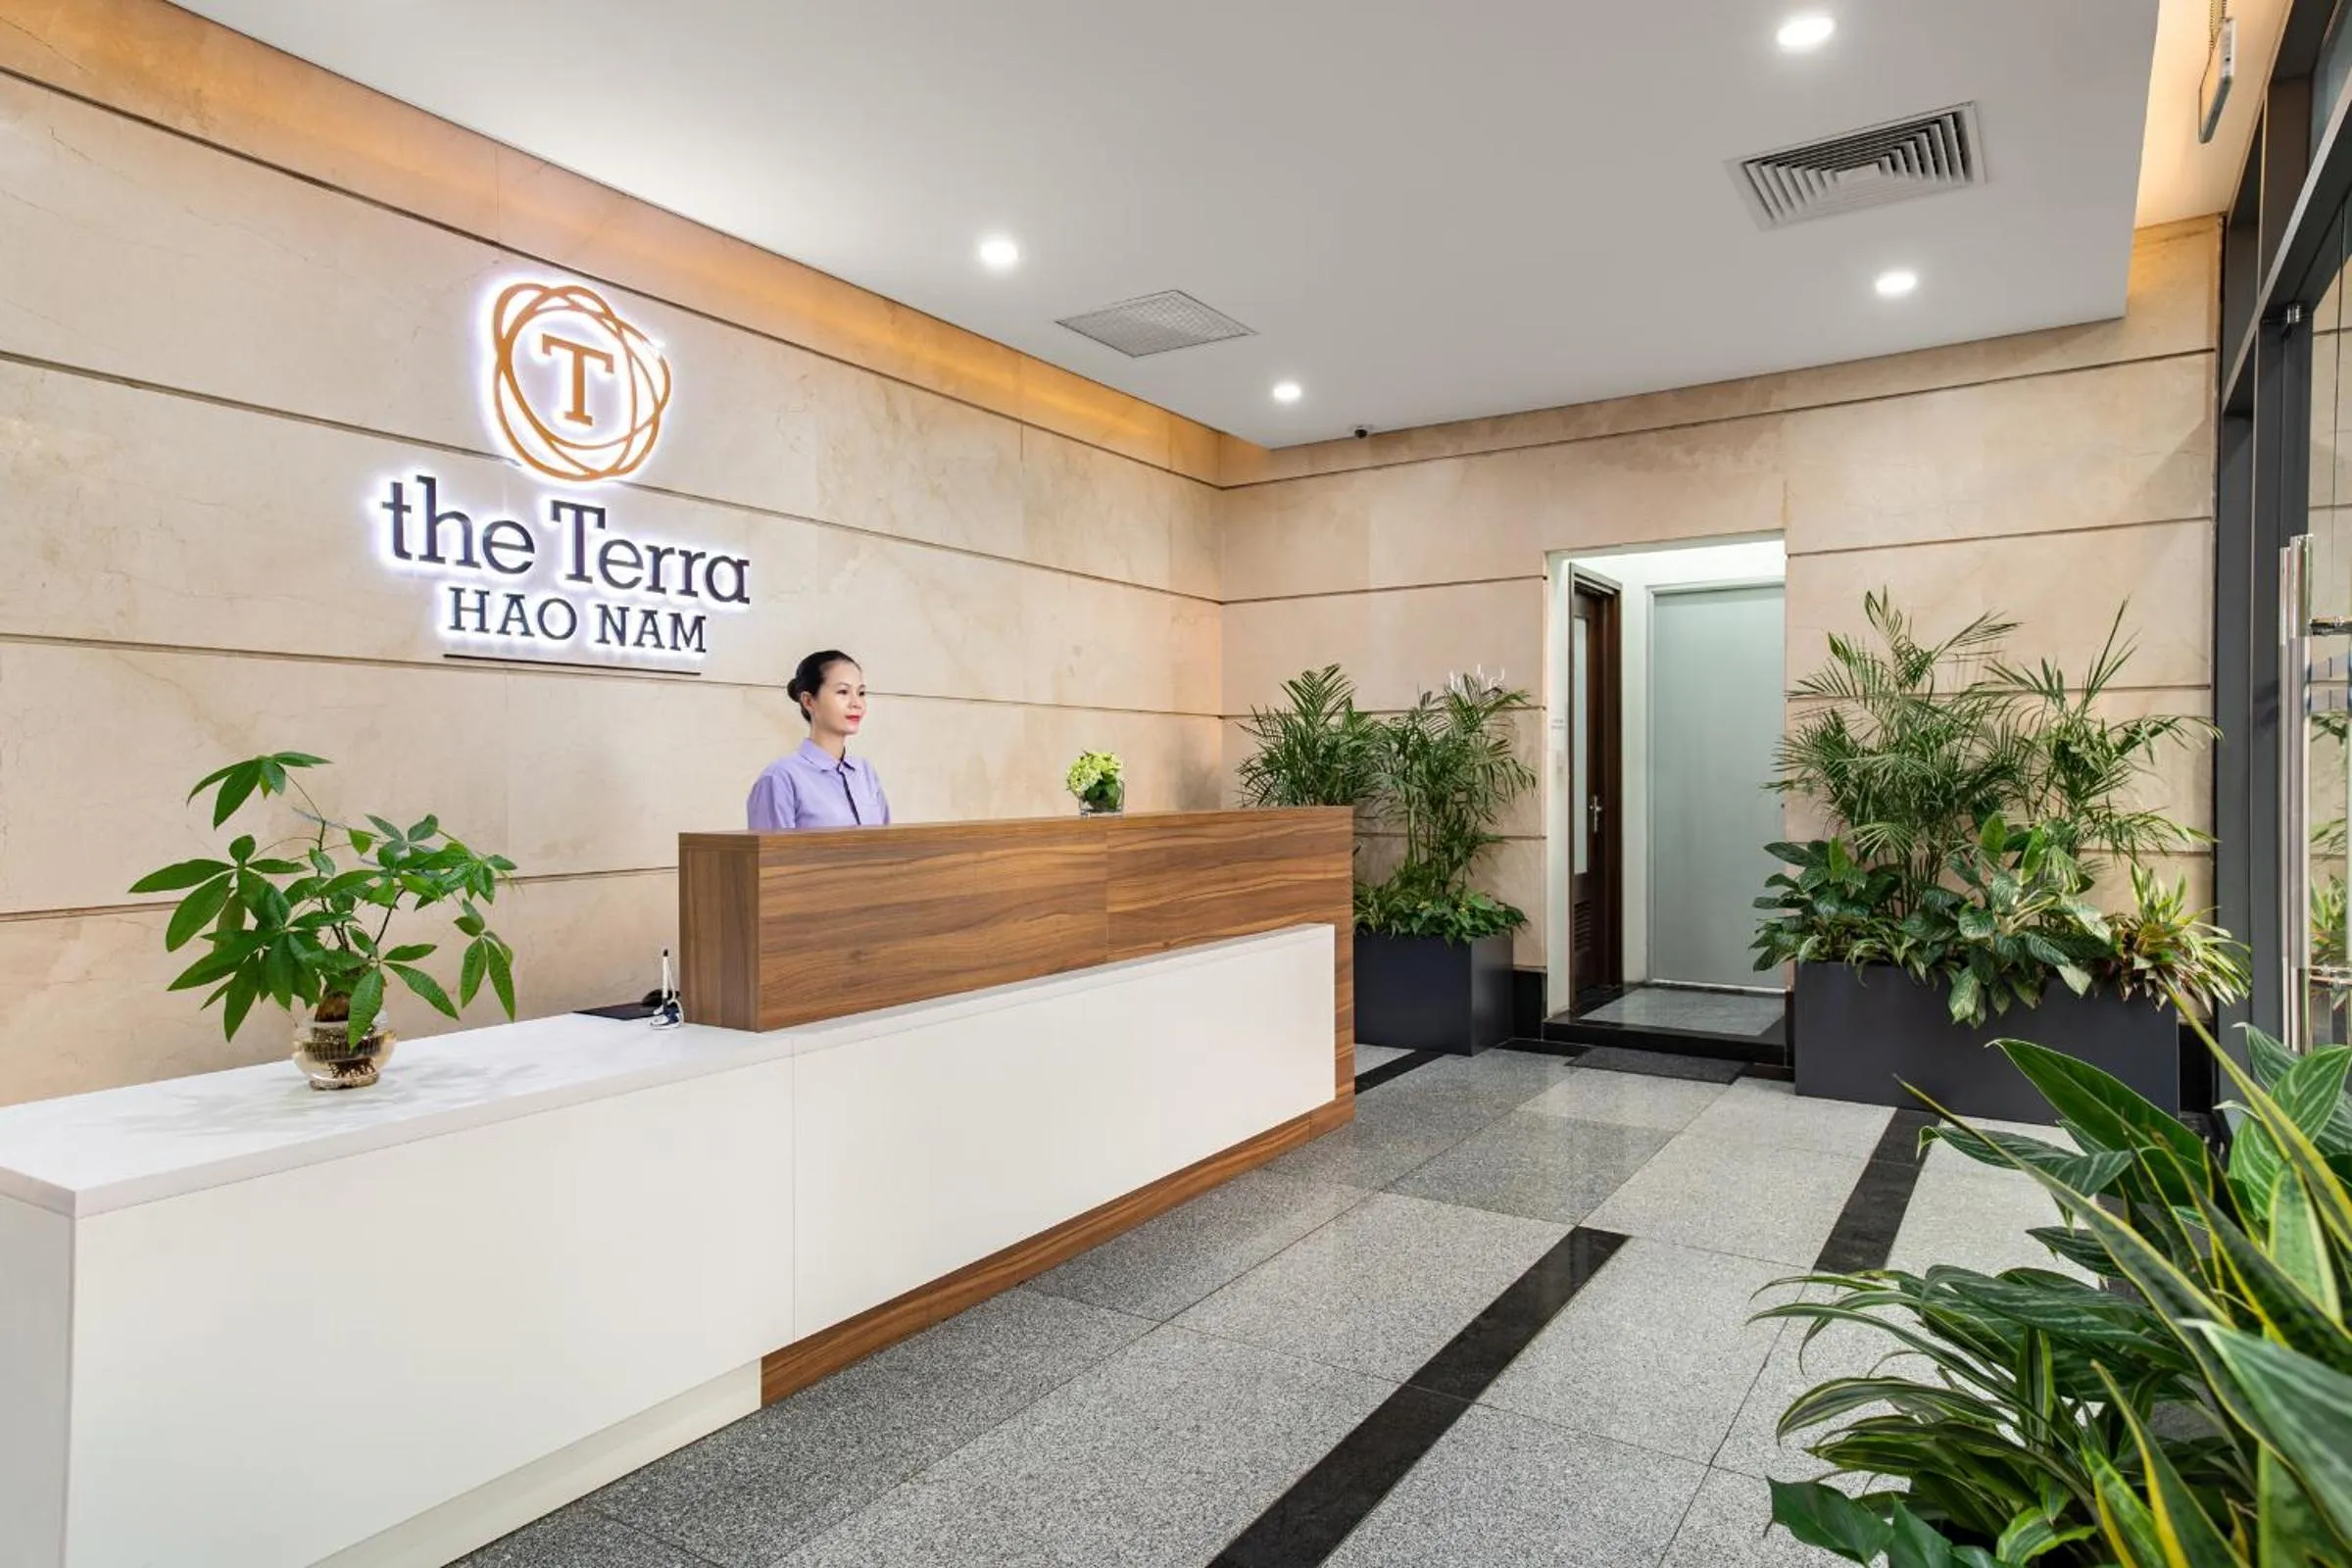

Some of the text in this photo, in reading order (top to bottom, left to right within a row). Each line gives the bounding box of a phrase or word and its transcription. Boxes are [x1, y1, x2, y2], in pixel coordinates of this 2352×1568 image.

[542, 333, 614, 425] T
[382, 475, 751, 605] the Terra
[448, 587, 707, 654] HAO NAM
